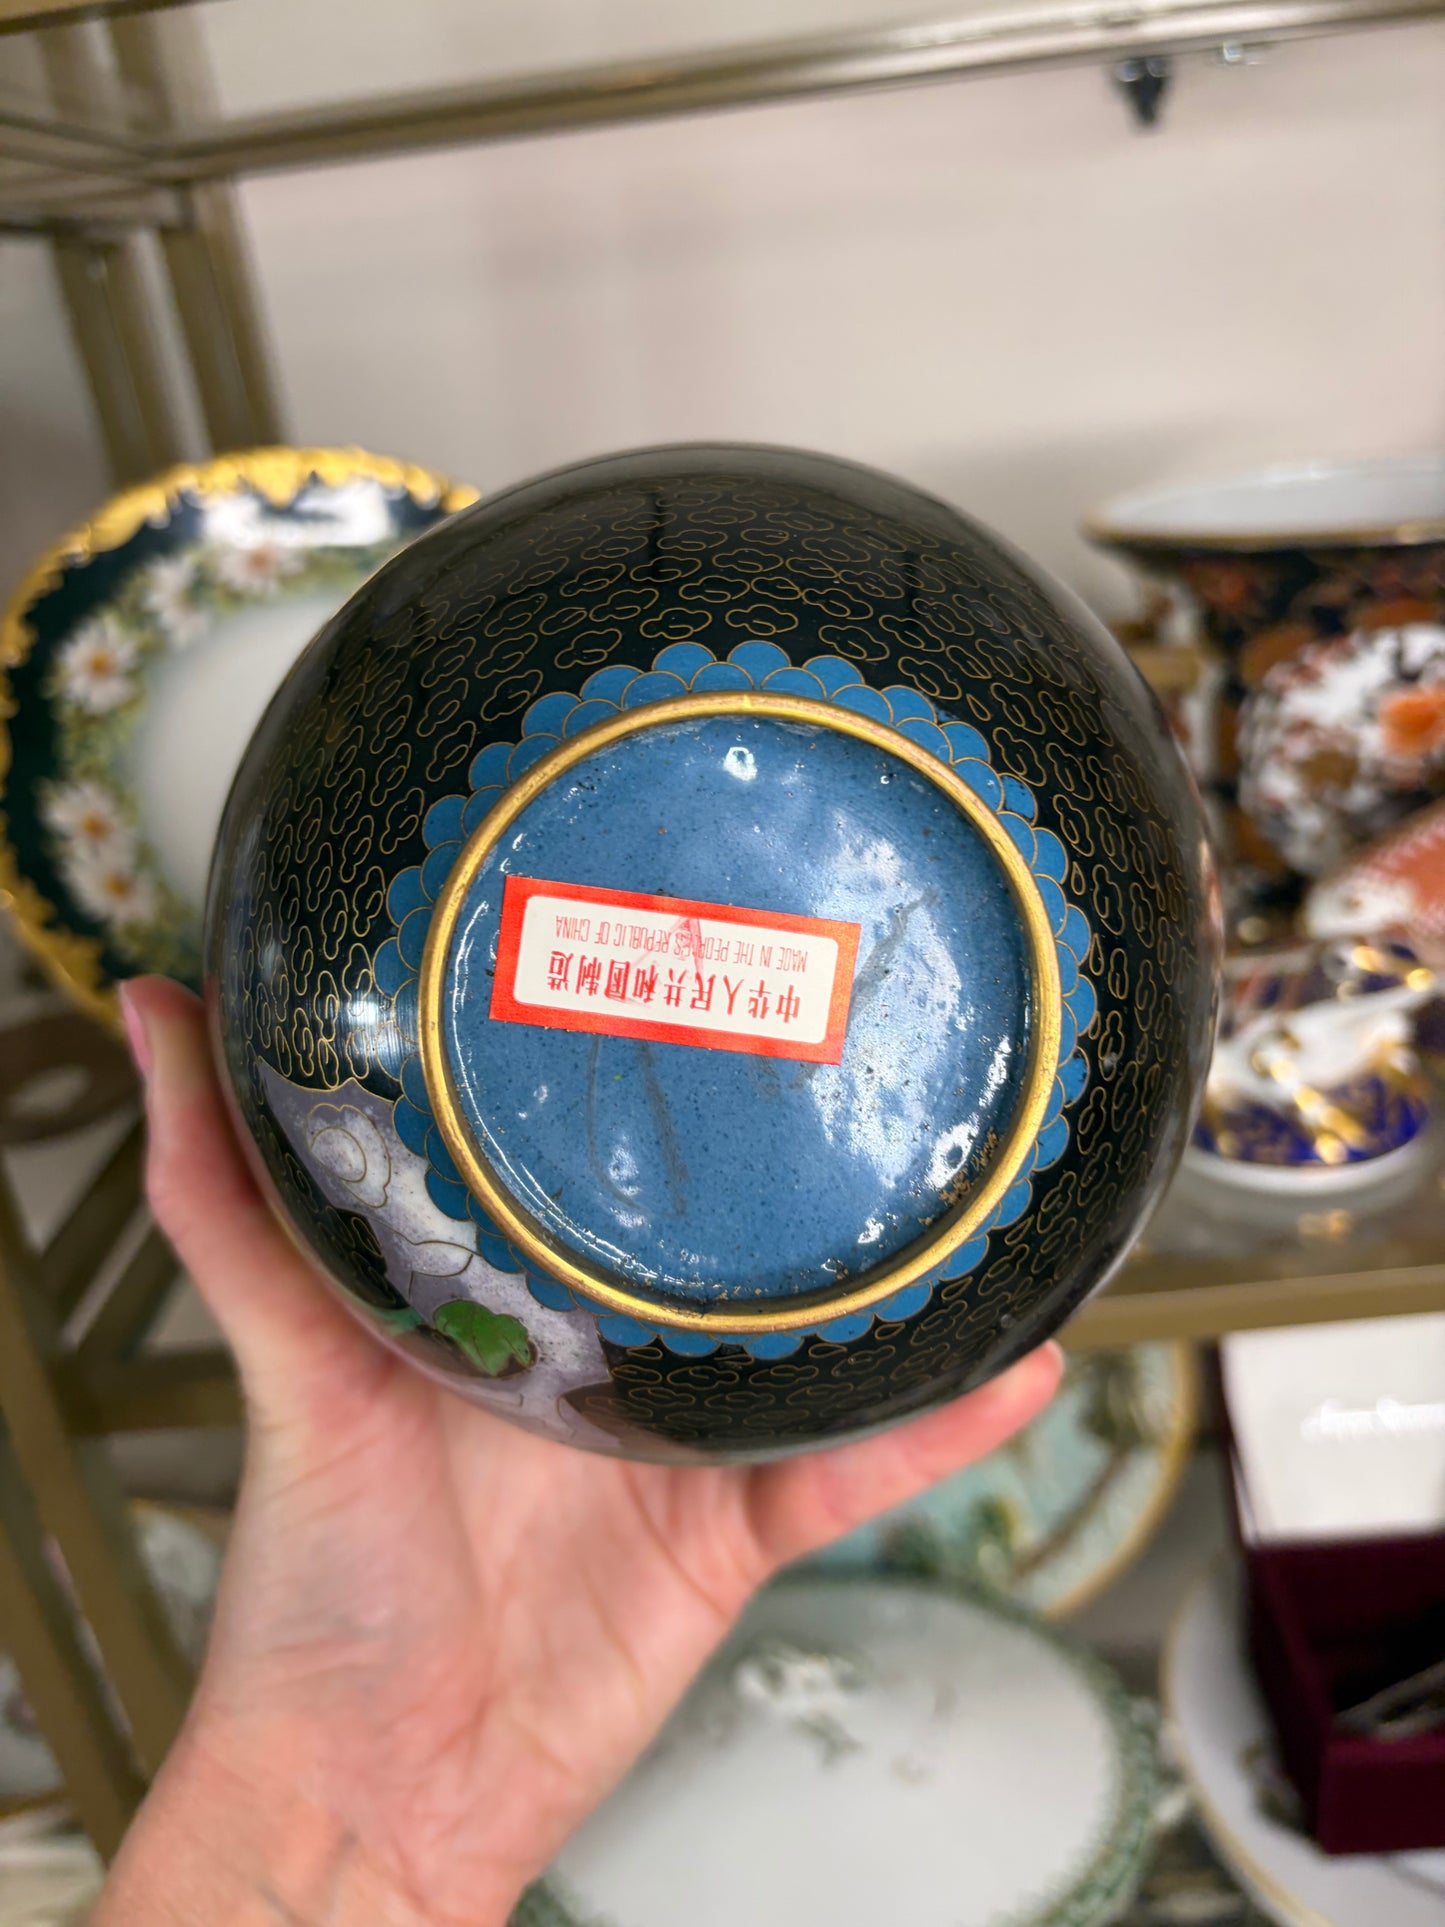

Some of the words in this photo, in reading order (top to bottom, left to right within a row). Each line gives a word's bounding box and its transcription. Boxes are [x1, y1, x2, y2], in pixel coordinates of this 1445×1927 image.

[556, 915, 591, 942] CHINA
[594, 921, 610, 945] OF
[613, 923, 671, 954] REPUBLIC
[673, 932, 730, 962] PEOPE'S
[733, 940, 755, 966] THE
[760, 944, 773, 968] IN
[776, 946, 808, 973] MADE
[547, 950, 801, 1023] 中华人民共和国制造
